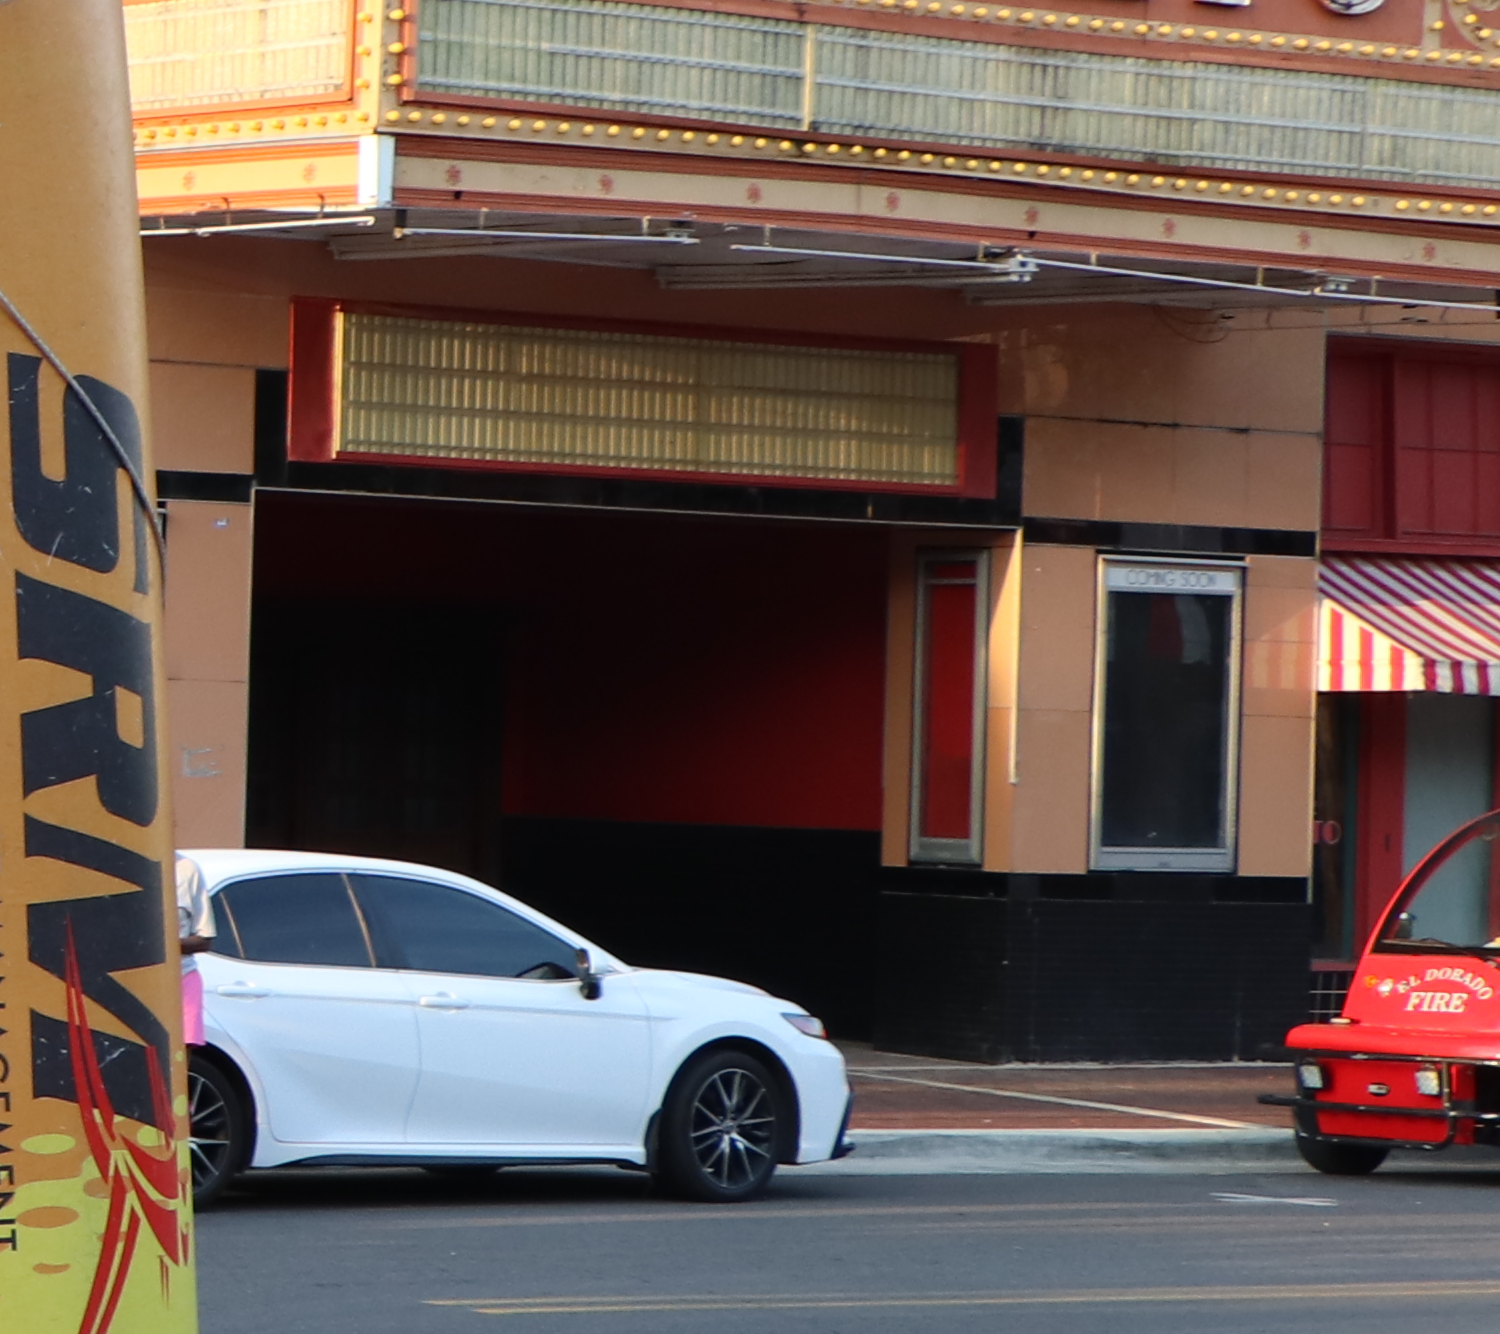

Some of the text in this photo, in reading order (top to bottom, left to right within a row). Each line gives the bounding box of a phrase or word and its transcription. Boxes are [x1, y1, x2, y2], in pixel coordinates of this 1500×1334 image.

[1396, 967, 1494, 1000] EL DORADO
[1403, 991, 1469, 1014] FIRE
